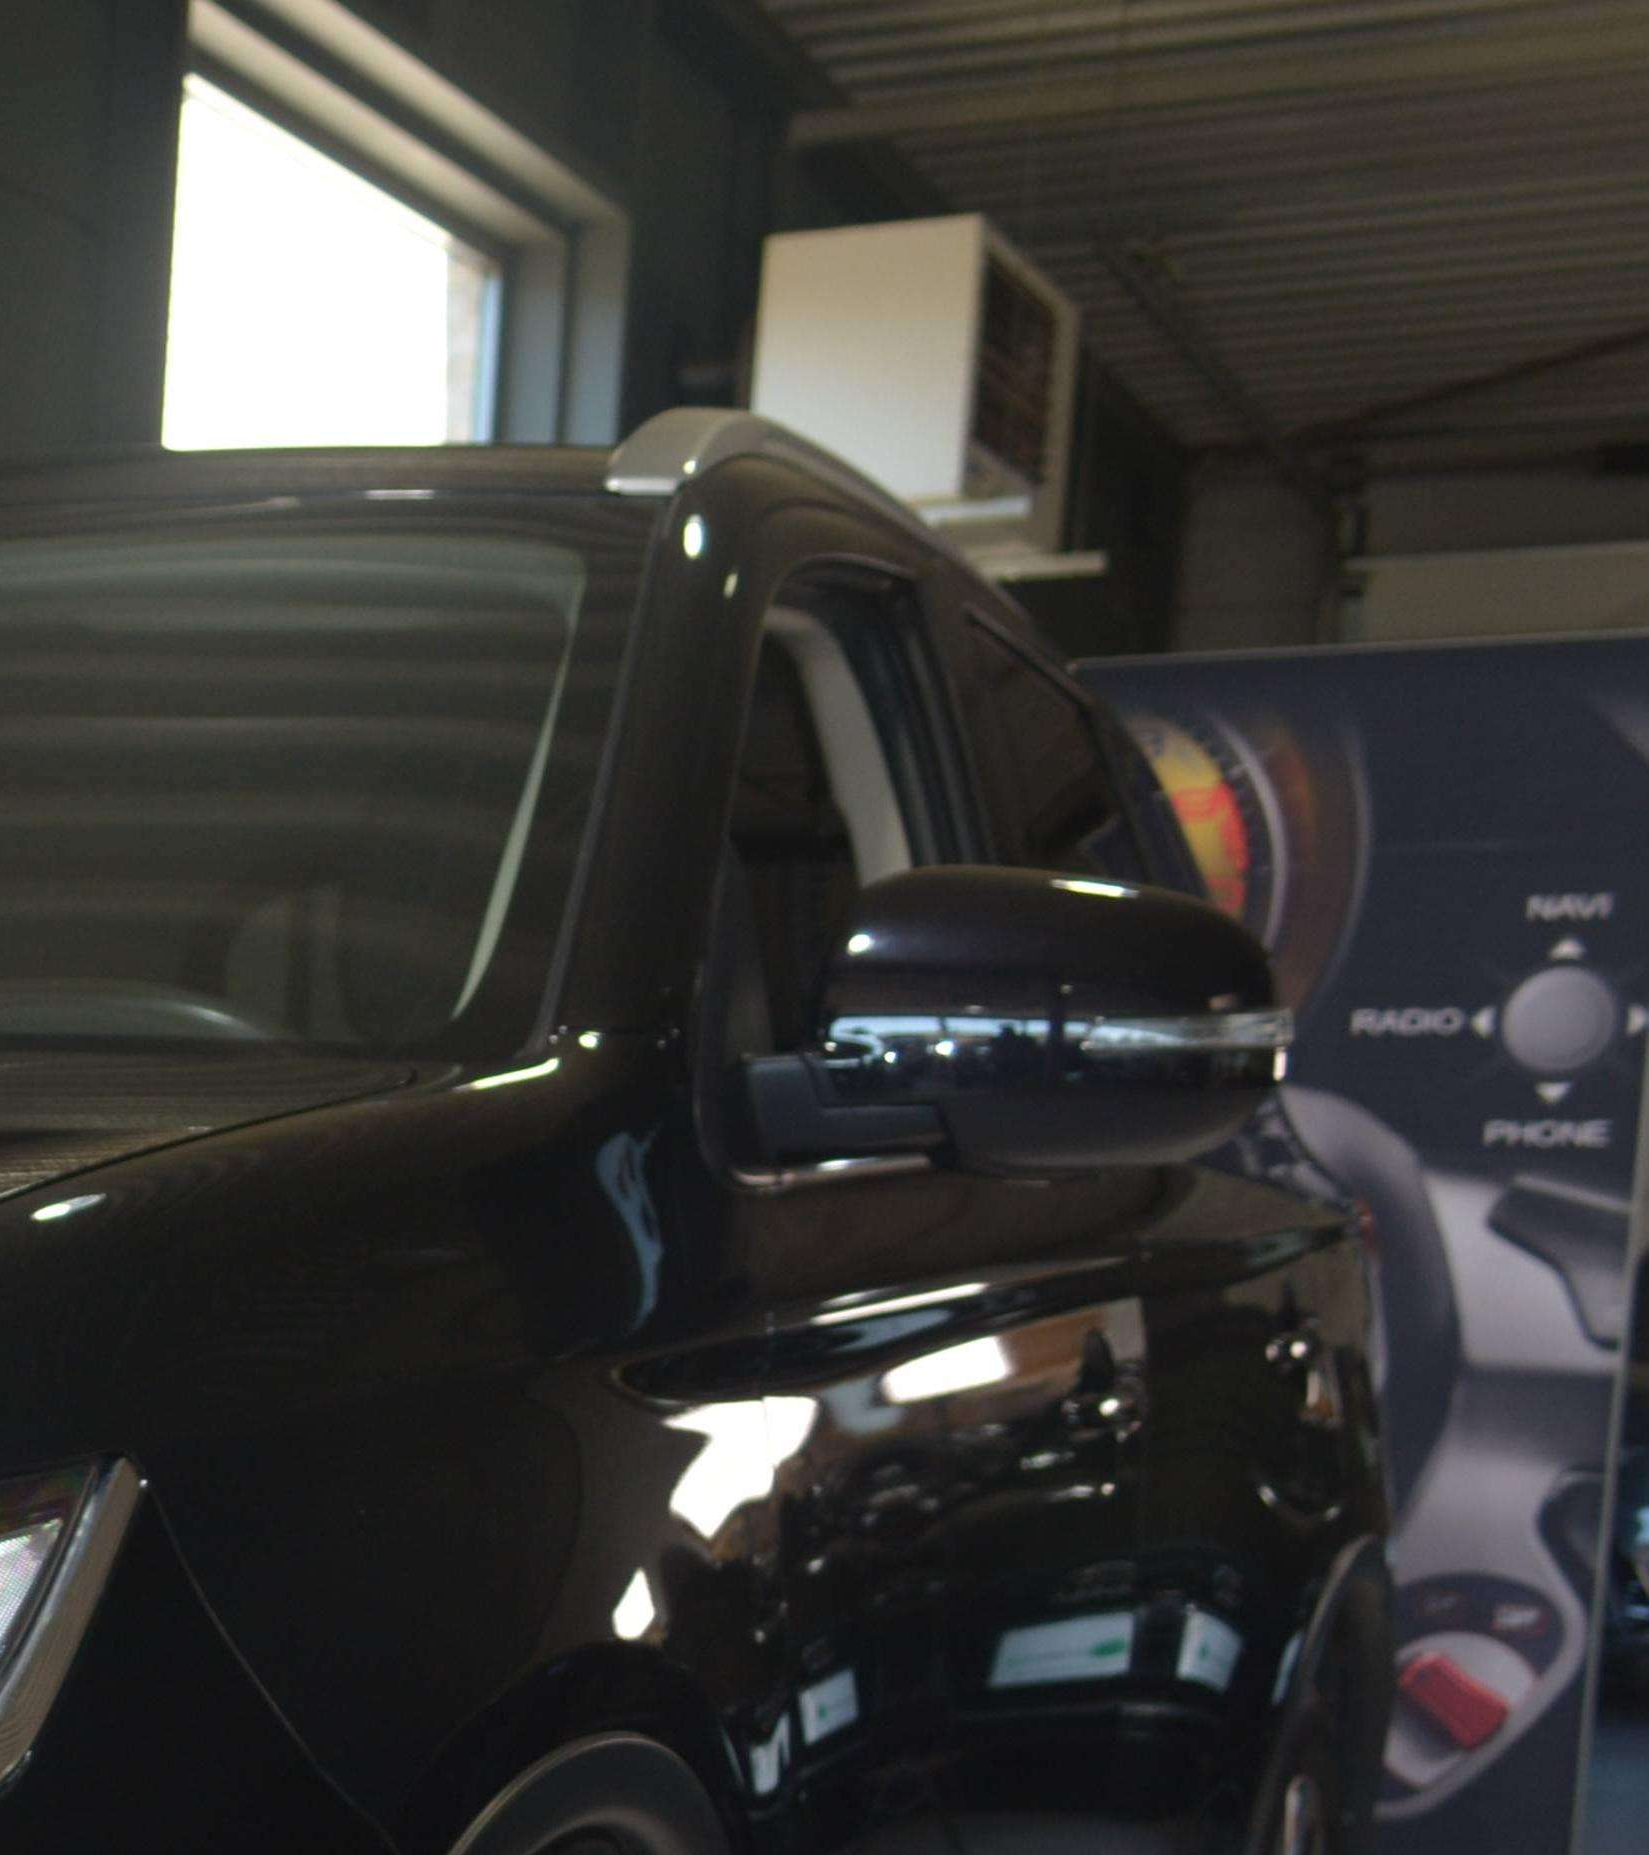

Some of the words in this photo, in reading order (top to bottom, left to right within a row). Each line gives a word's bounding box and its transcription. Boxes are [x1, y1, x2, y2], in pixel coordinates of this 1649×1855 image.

[1524, 892, 1614, 922] NAVI
[1349, 1006, 1465, 1037] RADIO
[1482, 1118, 1610, 1149] PHONE
